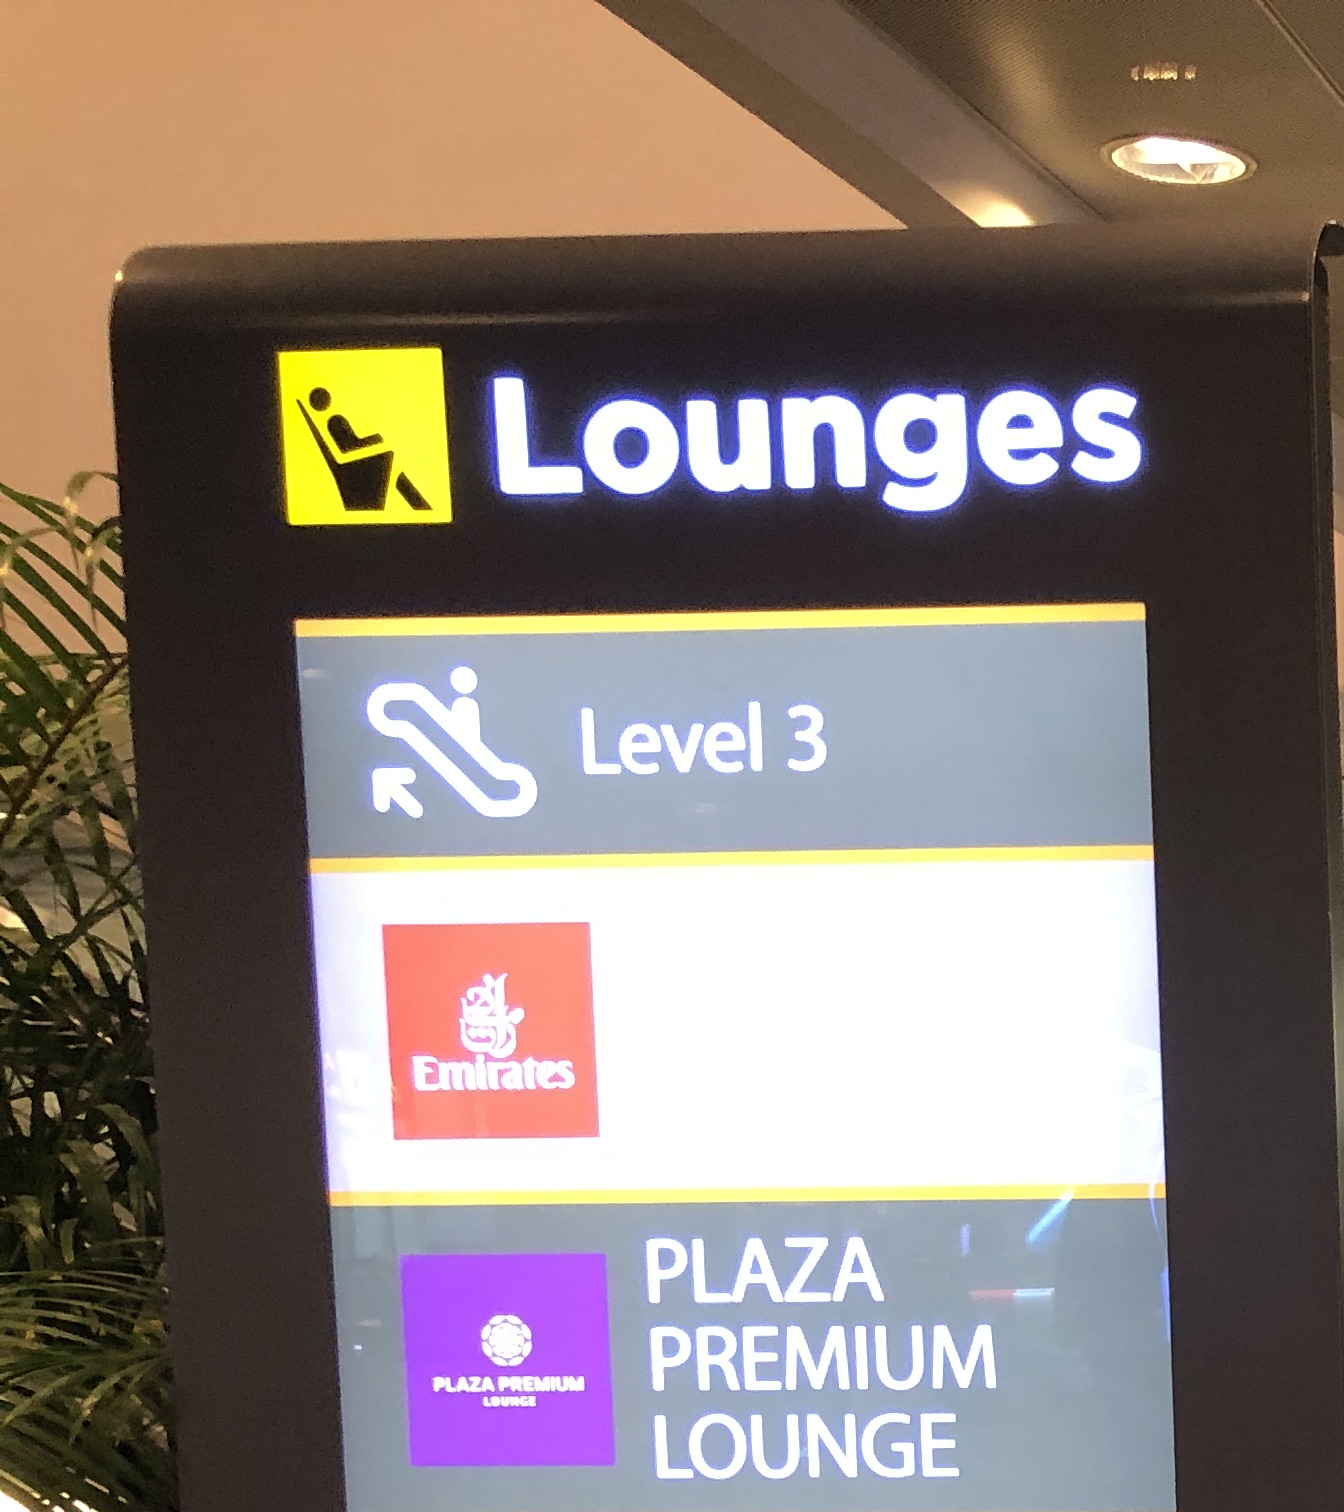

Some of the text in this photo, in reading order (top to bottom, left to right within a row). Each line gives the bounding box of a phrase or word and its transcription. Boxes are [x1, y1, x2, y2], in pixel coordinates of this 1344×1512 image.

[492, 378, 1142, 512] Lounges
[580, 700, 827, 776] Level 3
[411, 1054, 577, 1091] Emirates
[646, 1236, 885, 1304] PLAZA
[432, 1375, 586, 1393] PLAZA PREMIUM
[650, 1324, 997, 1392] PREMIUM
[482, 1395, 537, 1408] LOUNGE
[654, 1412, 960, 1480] LOUNGE
